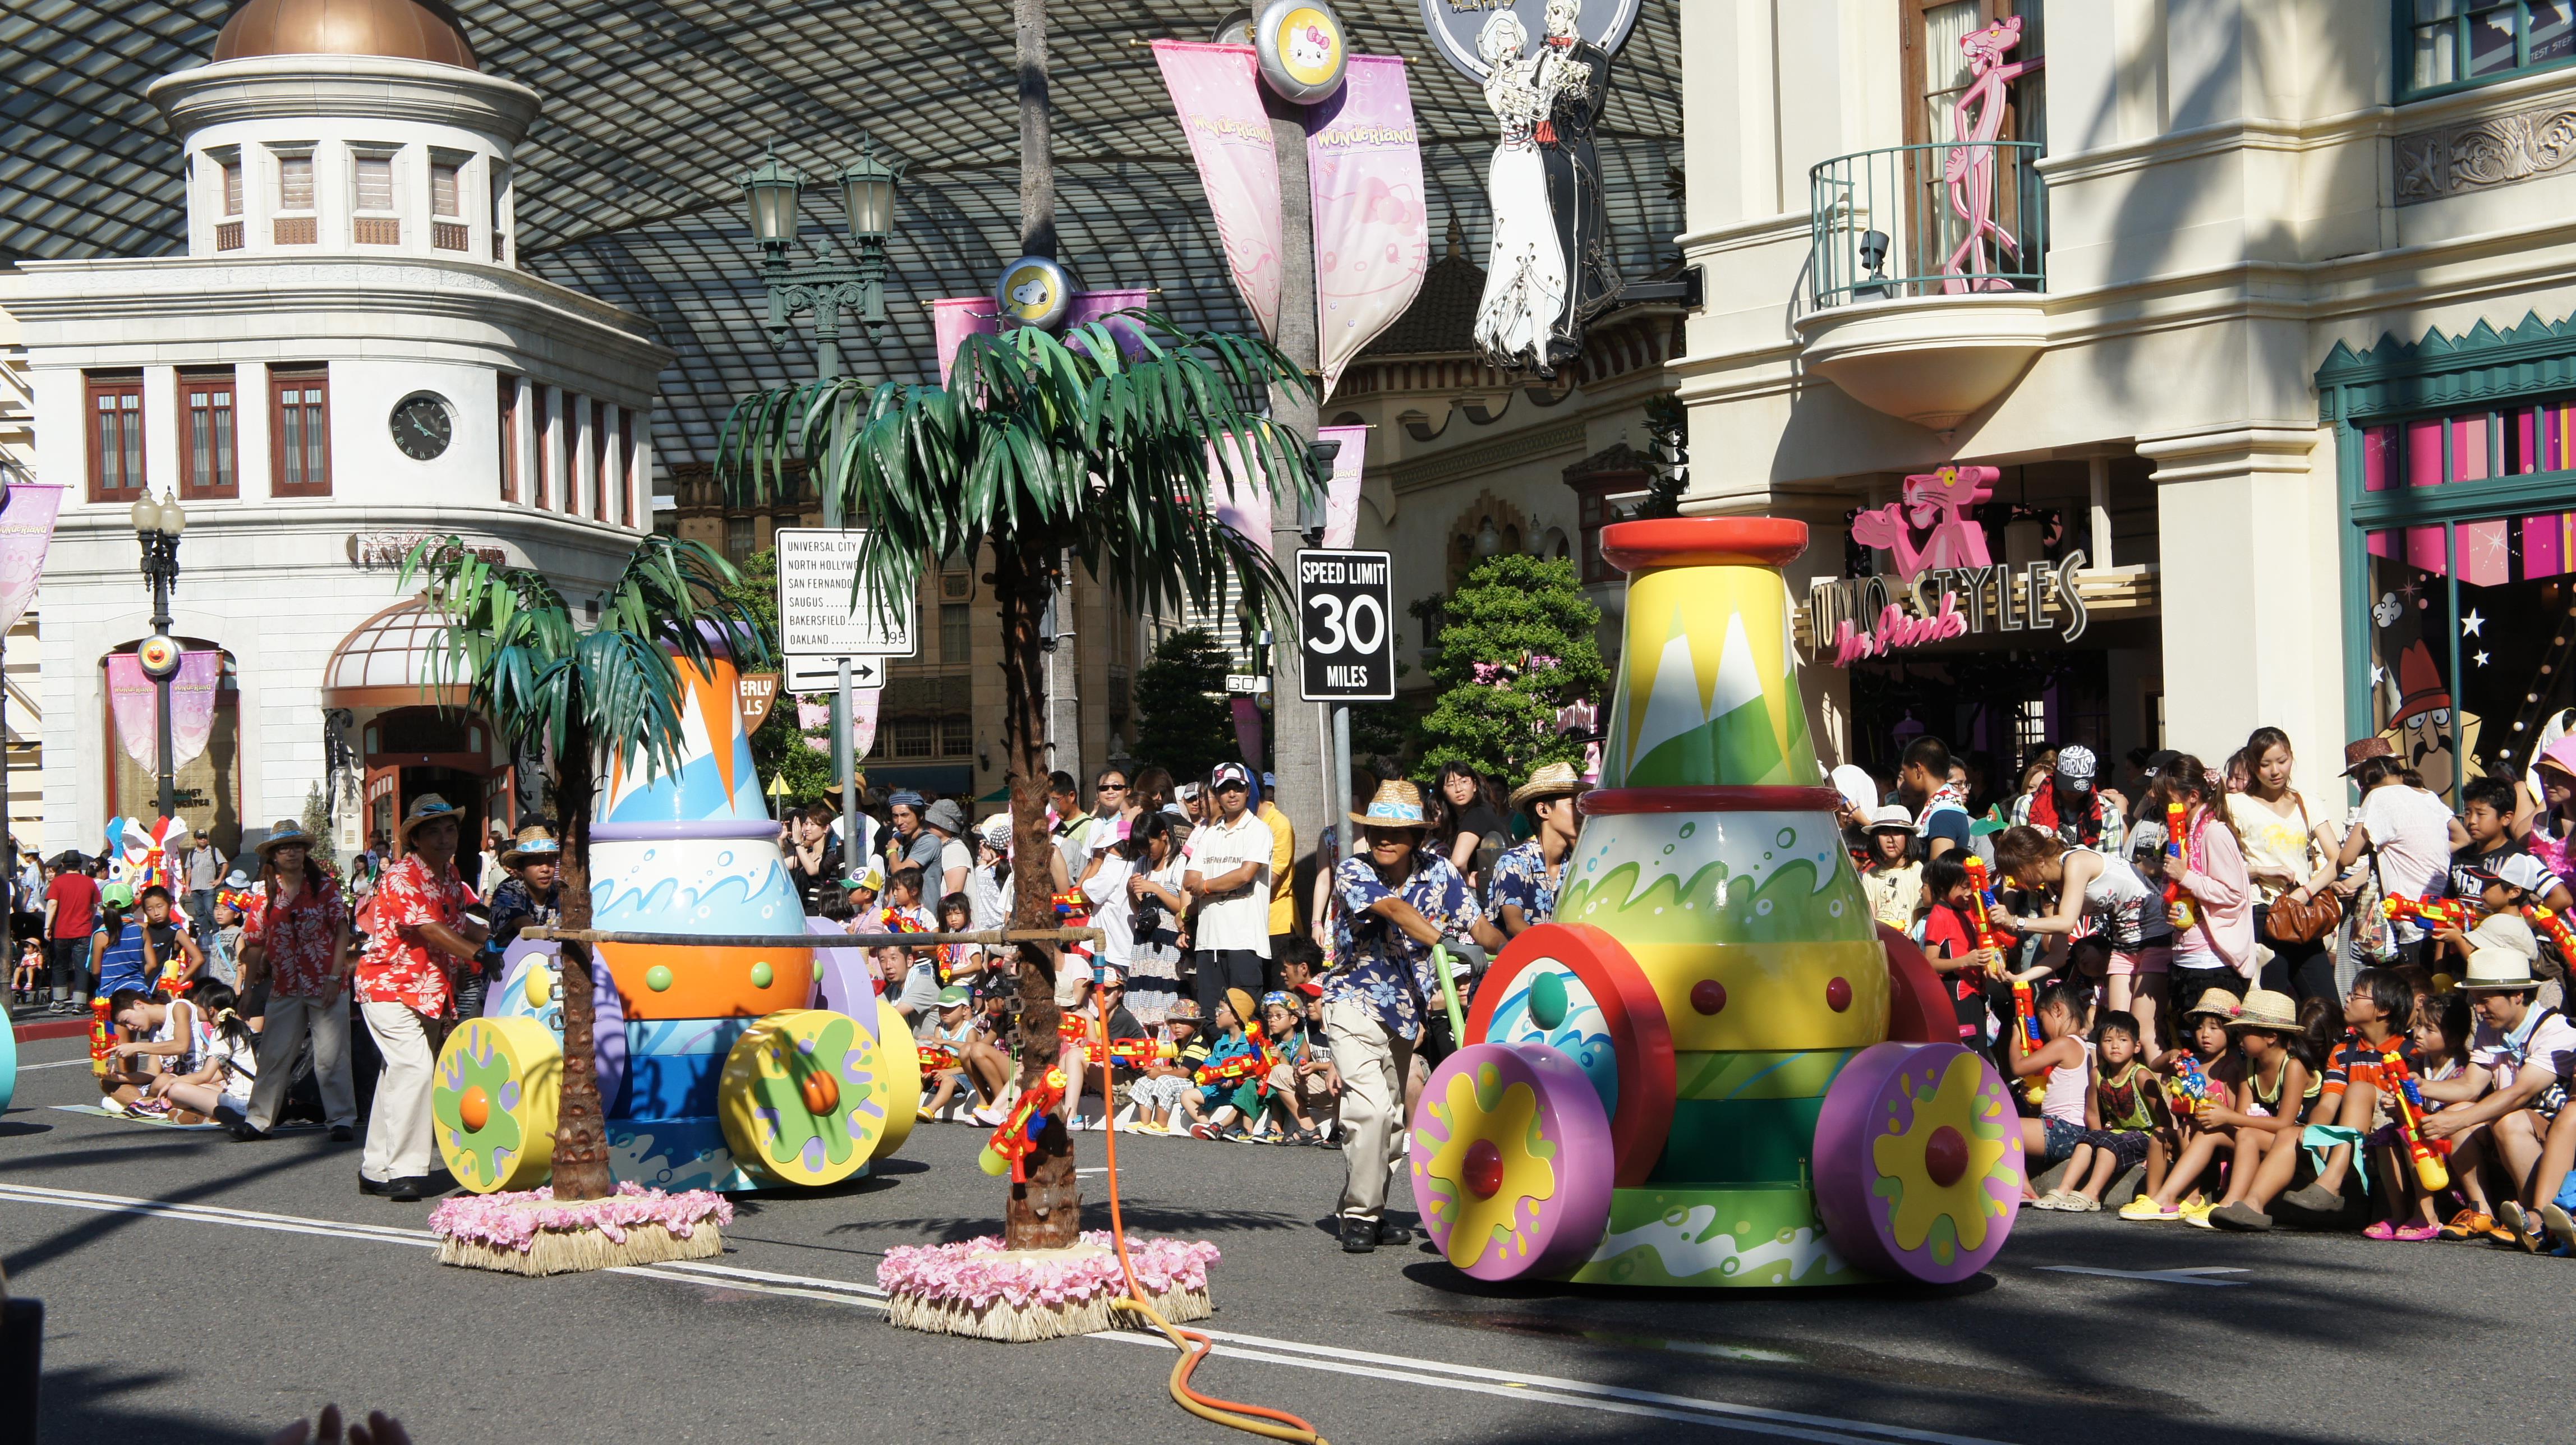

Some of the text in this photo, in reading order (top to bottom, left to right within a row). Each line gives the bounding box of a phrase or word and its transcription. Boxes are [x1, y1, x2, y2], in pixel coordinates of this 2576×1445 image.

[788, 541, 857, 552] UNIVERSAL CITY
[788, 560, 867, 570] NORTH HOLLYWO
[1302, 562, 1386, 585] SPEED LIMIT
[789, 578, 852, 589] SAN FERNANDO
[789, 597, 824, 608] SAUGUS
[1813, 549, 2087, 650] TUDIO STYLES
[790, 615, 846, 626] BAKERSFIELD
[1308, 593, 1385, 655] 30
[1833, 591, 1967, 668] In Pink
[790, 632, 907, 645] OAKLAND 395
[1227, 677, 1255, 690] GO
[1327, 665, 1368, 687] MILES
[740, 680, 772, 696] ERLY
[744, 700, 763, 715] LS
[2060, 756, 2091, 775] HORNS
